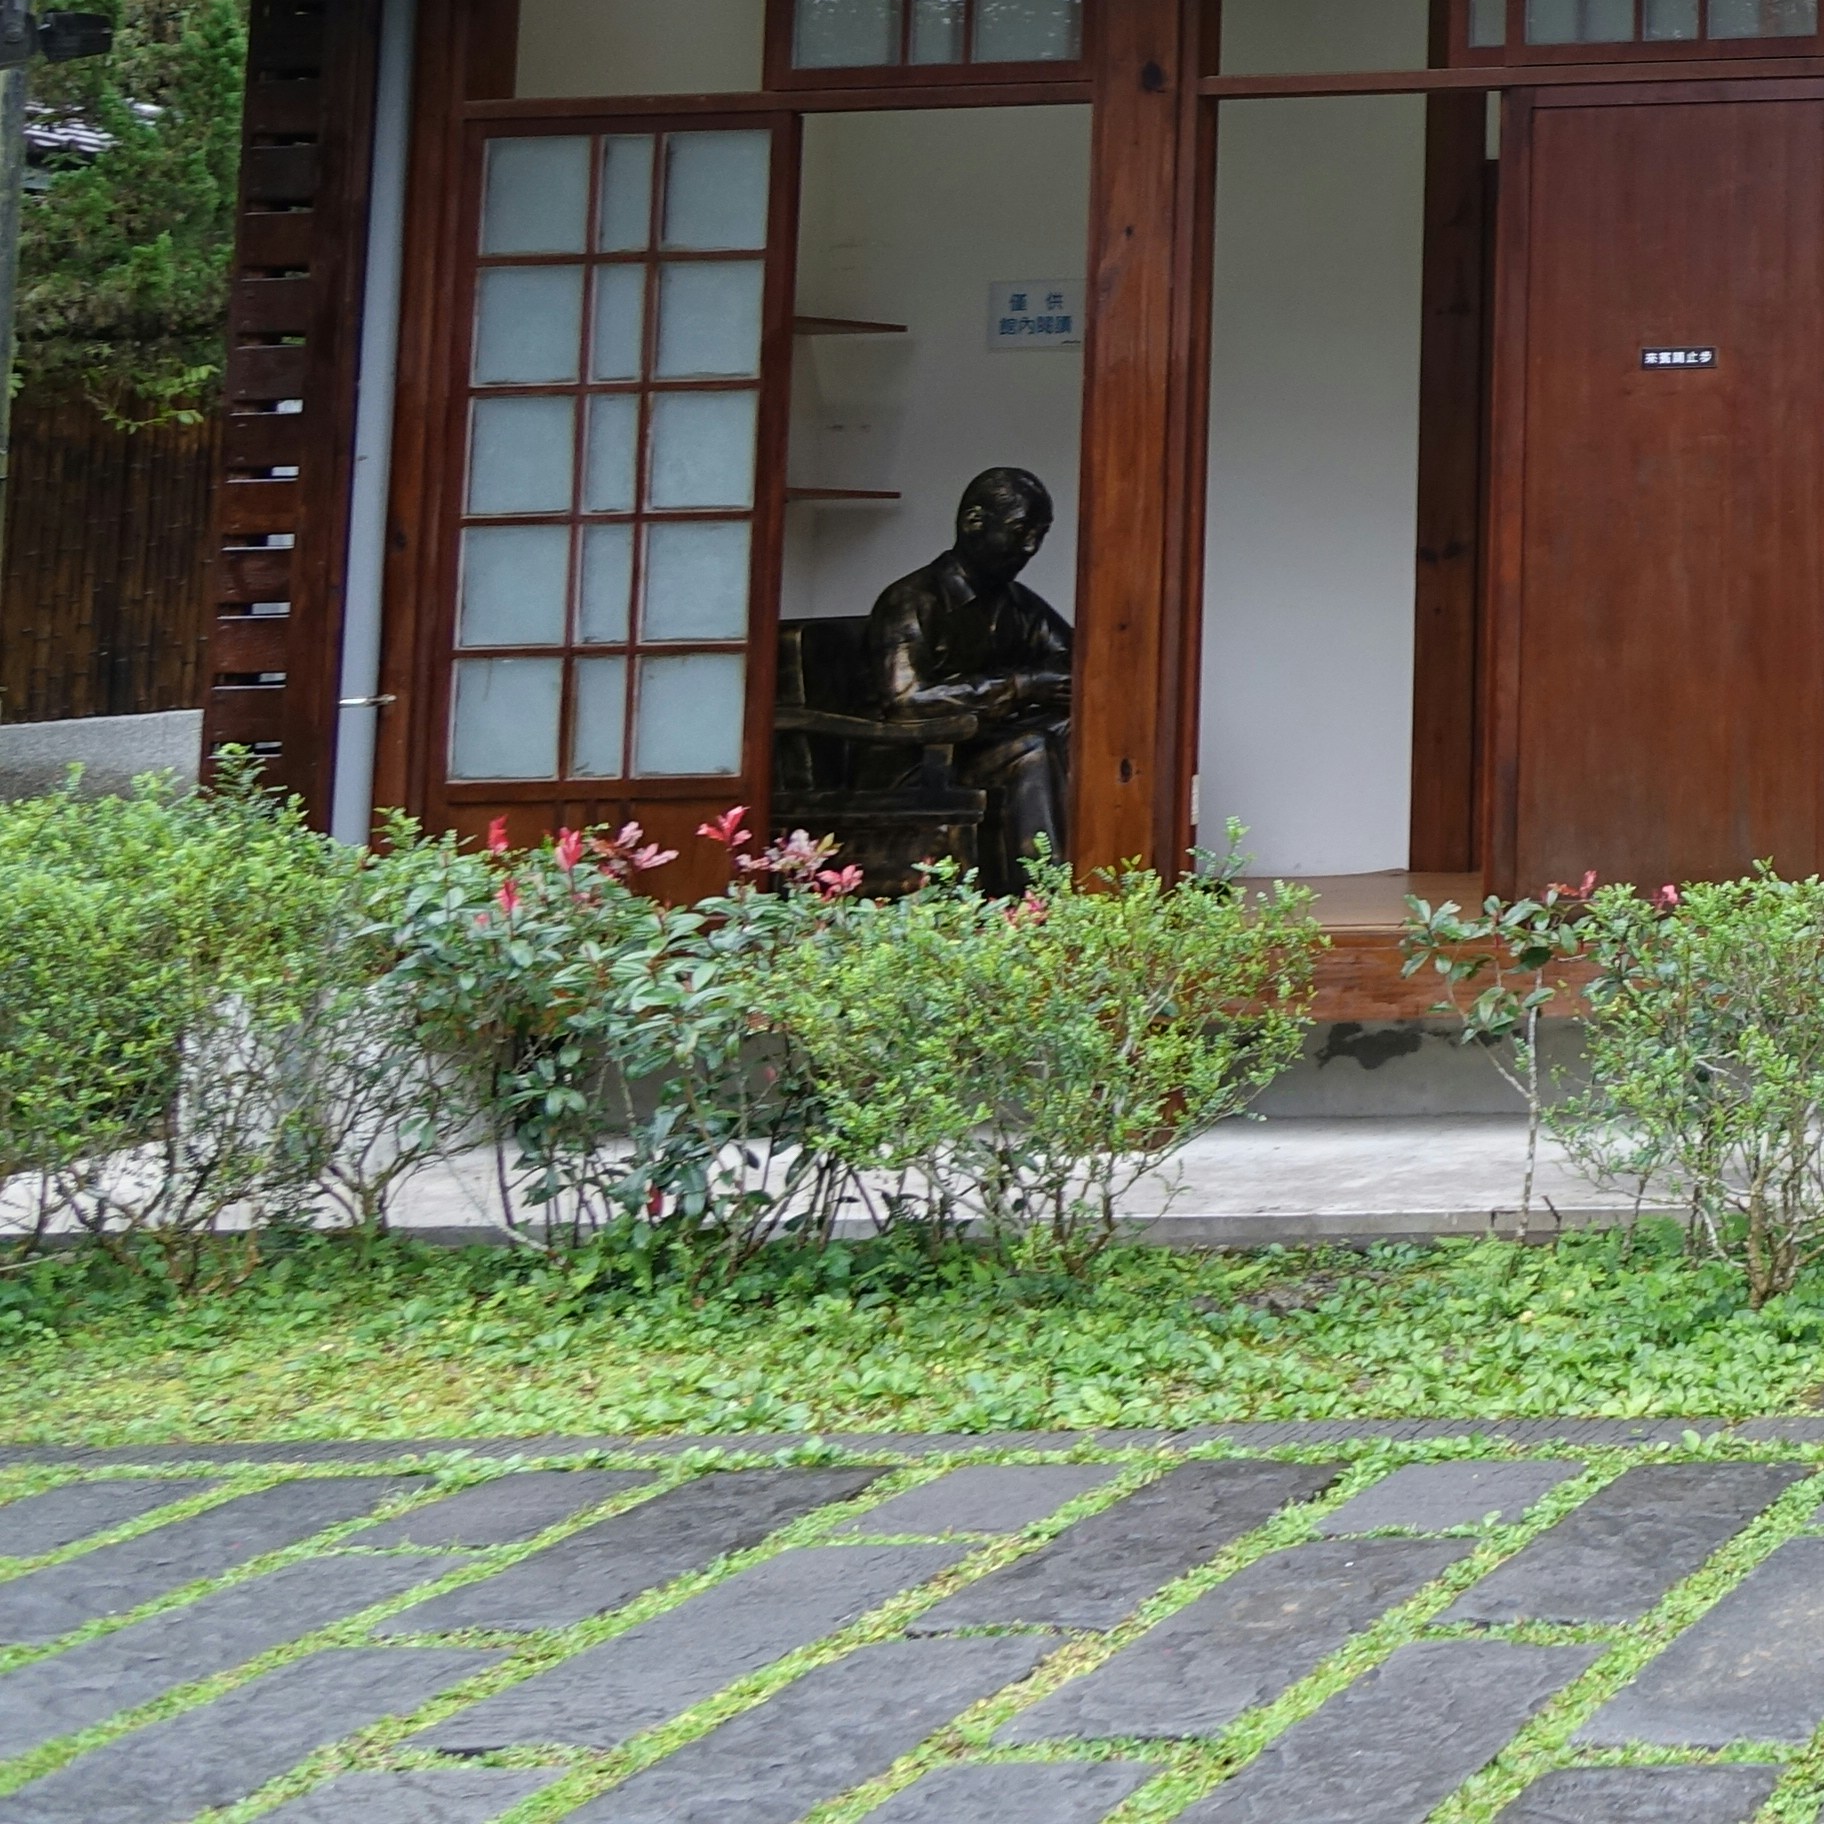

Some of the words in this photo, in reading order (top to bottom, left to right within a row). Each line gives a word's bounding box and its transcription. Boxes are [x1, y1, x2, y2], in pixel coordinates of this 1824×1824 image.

[1644, 350, 1713, 364] 來賓請止步
